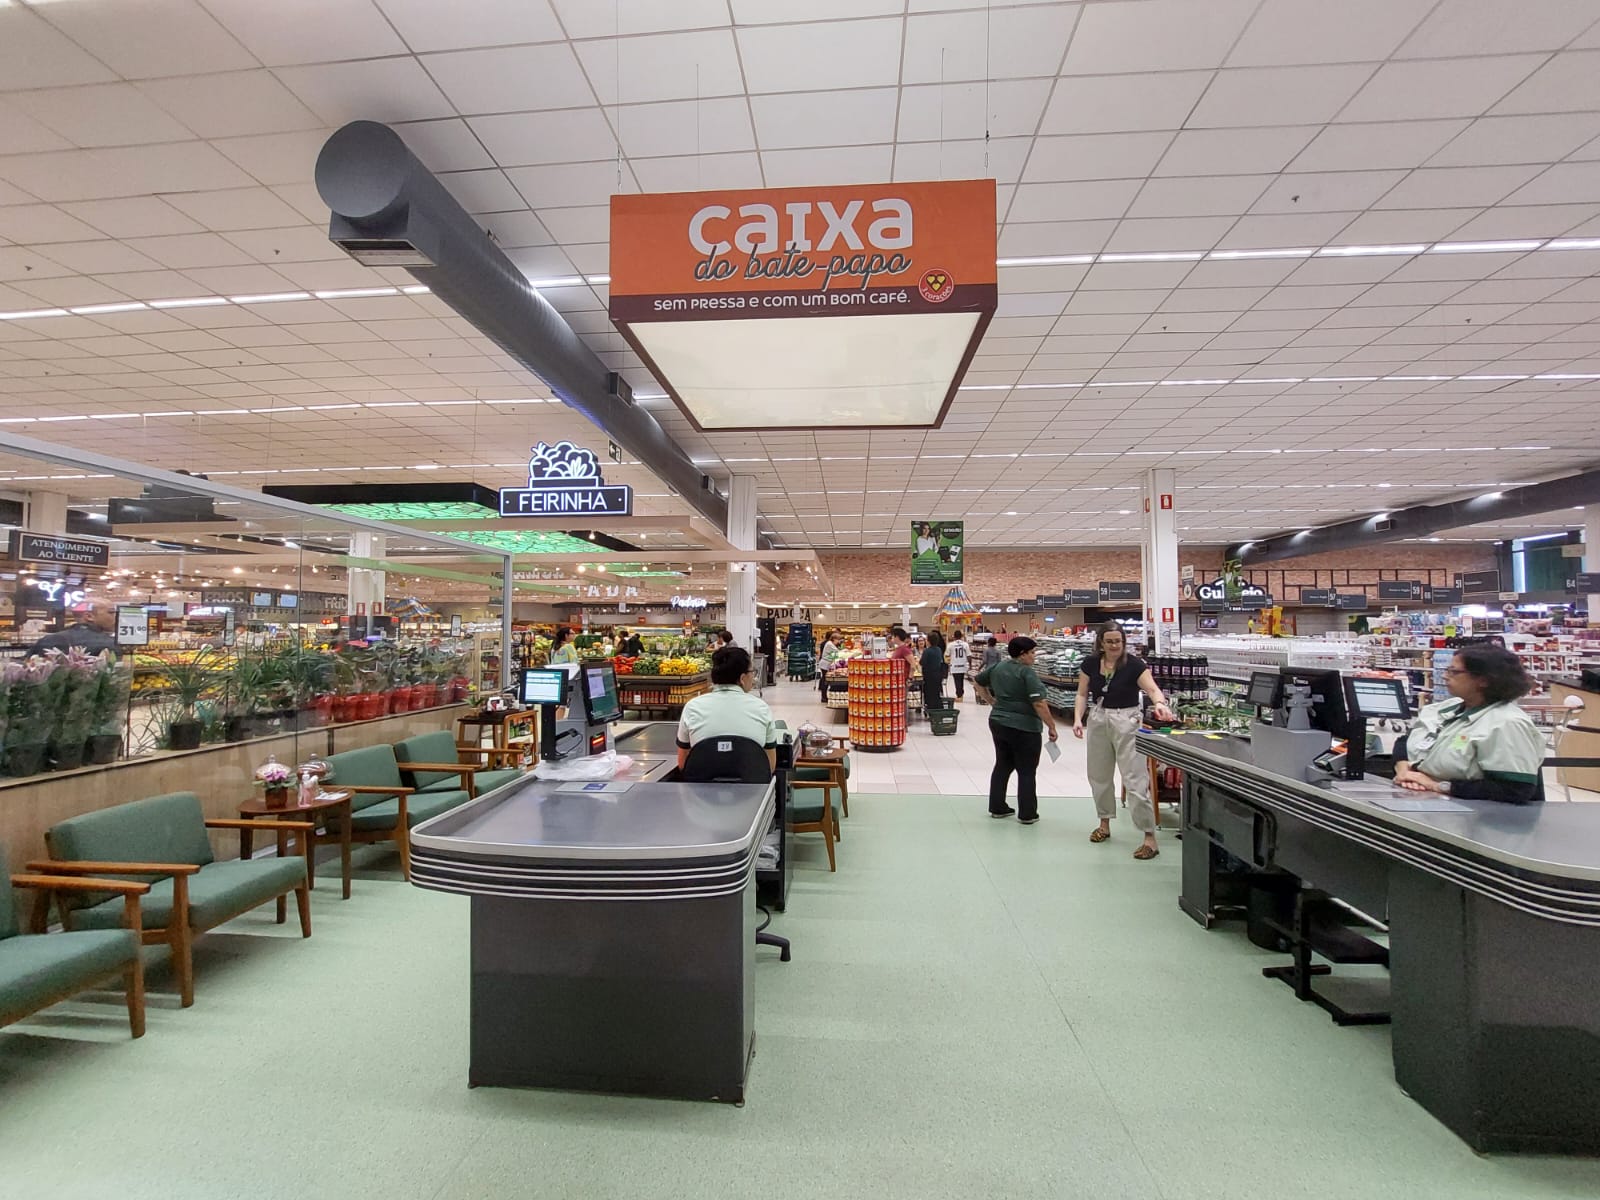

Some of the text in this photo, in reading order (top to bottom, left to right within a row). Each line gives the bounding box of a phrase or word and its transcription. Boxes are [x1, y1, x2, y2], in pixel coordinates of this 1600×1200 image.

[694, 242, 912, 291] do bate-papo
[749, 296, 759, 308] e
[763, 295, 797, 307] com
[519, 491, 607, 511] FEIRINHA
[31, 539, 102, 554] ATENDIMENTO
[38, 550, 95, 563] AO CLIENTE
[1412, 586, 1420, 595] 59
[955, 648, 964, 658] 10
